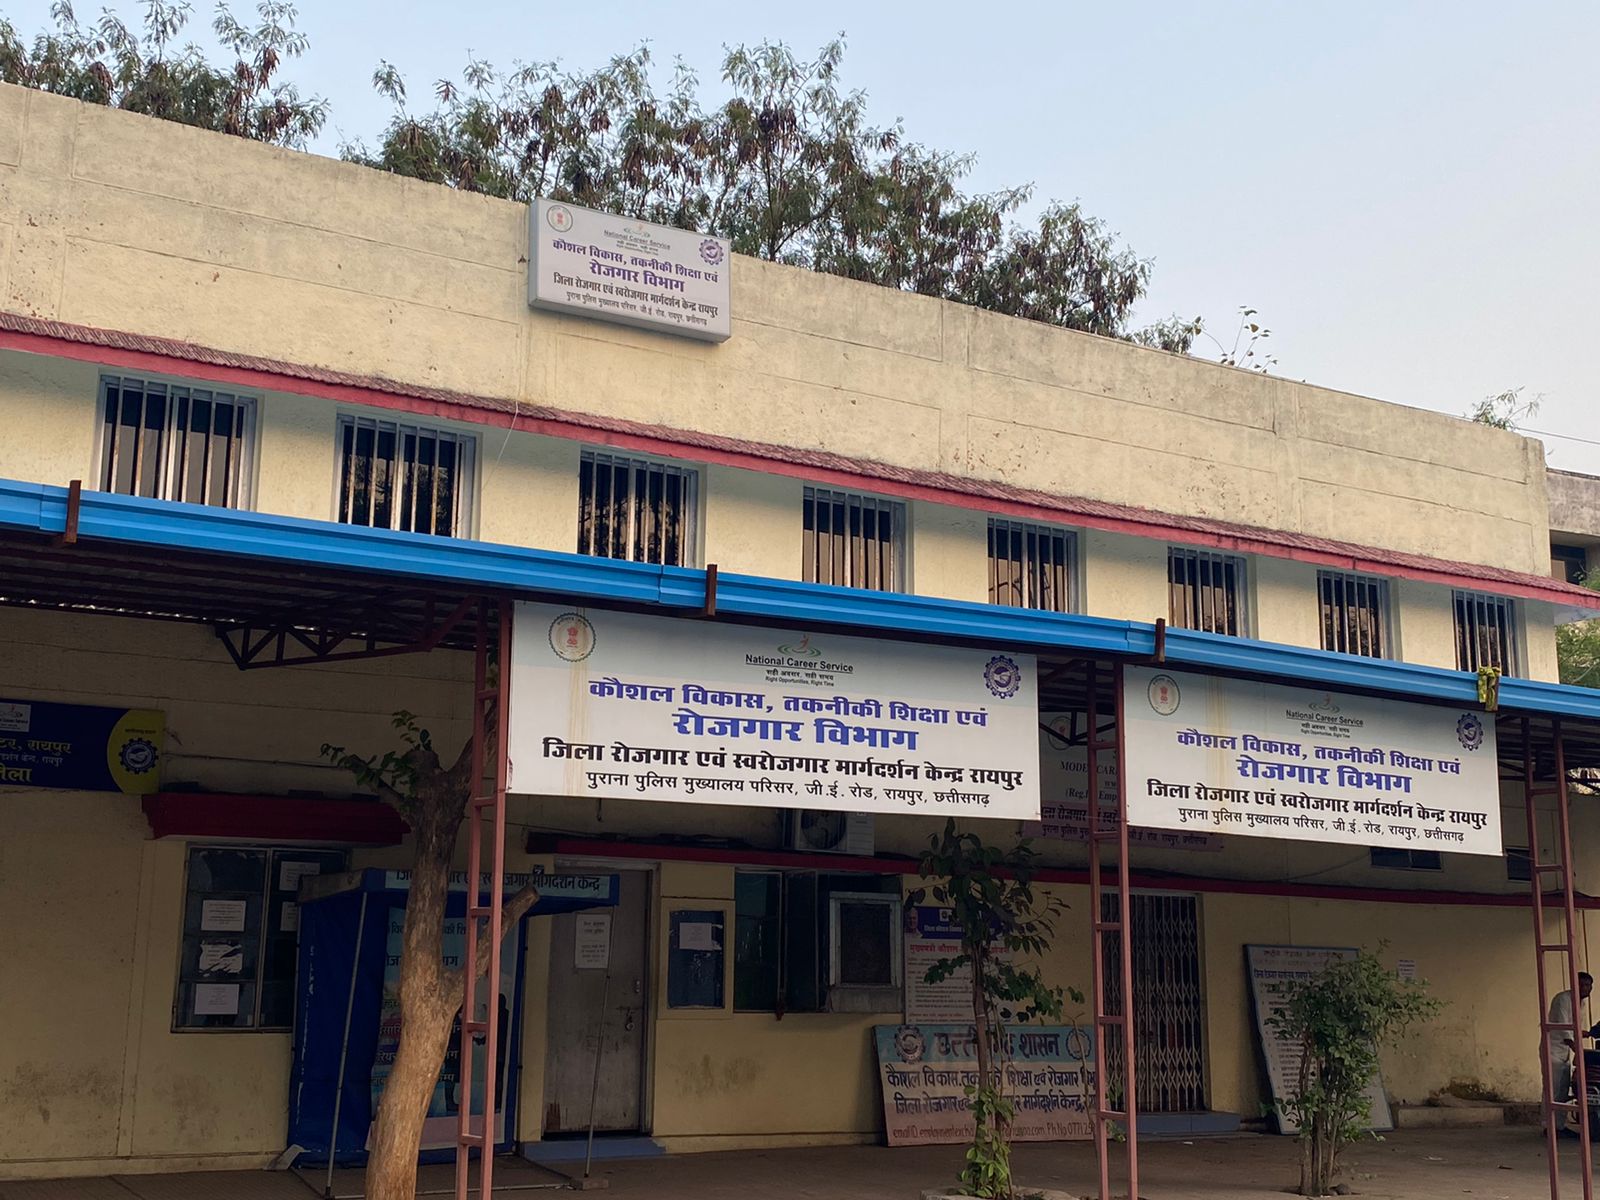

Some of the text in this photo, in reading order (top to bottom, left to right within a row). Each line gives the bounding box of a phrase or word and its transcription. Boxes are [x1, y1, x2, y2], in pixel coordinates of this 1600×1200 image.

[552, 238, 587, 255] कौशल
[630, 255, 673, 273] तकनीकी
[675, 264, 702, 280] शिक्षा
[704, 271, 718, 283] एवं
[589, 259, 685, 292] रोजगार विभाग
[553, 272, 718, 318] जिला रोजगार एवं स्वरोजगार मार्गदर्शन केन्द्र रायपुर
[745, 654, 854, 673] National Career Service
[588, 676, 989, 727] कौशल विकास, तकनीकी शिक्षा एवं
[1285, 709, 1364, 726] National Career Service
[671, 707, 920, 751] रोजगार विभाग
[26, 740, 72, 757] रायपुर
[541, 737, 1024, 791] जिला रोजगार एवं स्वरोजगार मार्गदर्शन केन्द्र रायपुर
[1060, 760, 1088, 773] MODE
[1176, 728, 1460, 775] कौशल विकास, तकनीकी शिक्षा एवं
[586, 771, 629, 790] पुराना
[634, 771, 678, 792] पुलिस
[682, 776, 745, 795] मुख्यालय
[749, 776, 799, 797] परिसर,
[848, 782, 878, 801] रोड,
[883, 788, 928, 806] रायपुर,
[933, 788, 990, 808] छत्तीसगढ़
[1236, 754, 1412, 794] रोजगार विभाग
[1146, 778, 1488, 830] जिला रोजगार एवं स्वरोजगार मार्गदर्शन केन्द्र रायपुर
[1177, 807, 1209, 823] पुराना
[1212, 807, 1243, 825] पुलिस
[1246, 812, 1290, 828] मुख्यालय
[1293, 814, 1329, 832] परिसर,
[1388, 825, 1420, 841] रायपुर,
[1424, 827, 1465, 845] छत्तीसगढ़
[1019, 1032, 1060, 1058] शासन
[1034, 1068, 1047, 1086] एवं
[1047, 1065, 1079, 1087] रोजगार
[894, 1091, 922, 1114] जिला
[922, 1090, 958, 1113] रोजगार
[1021, 1089, 1059, 1113] मार्गदर्शन
